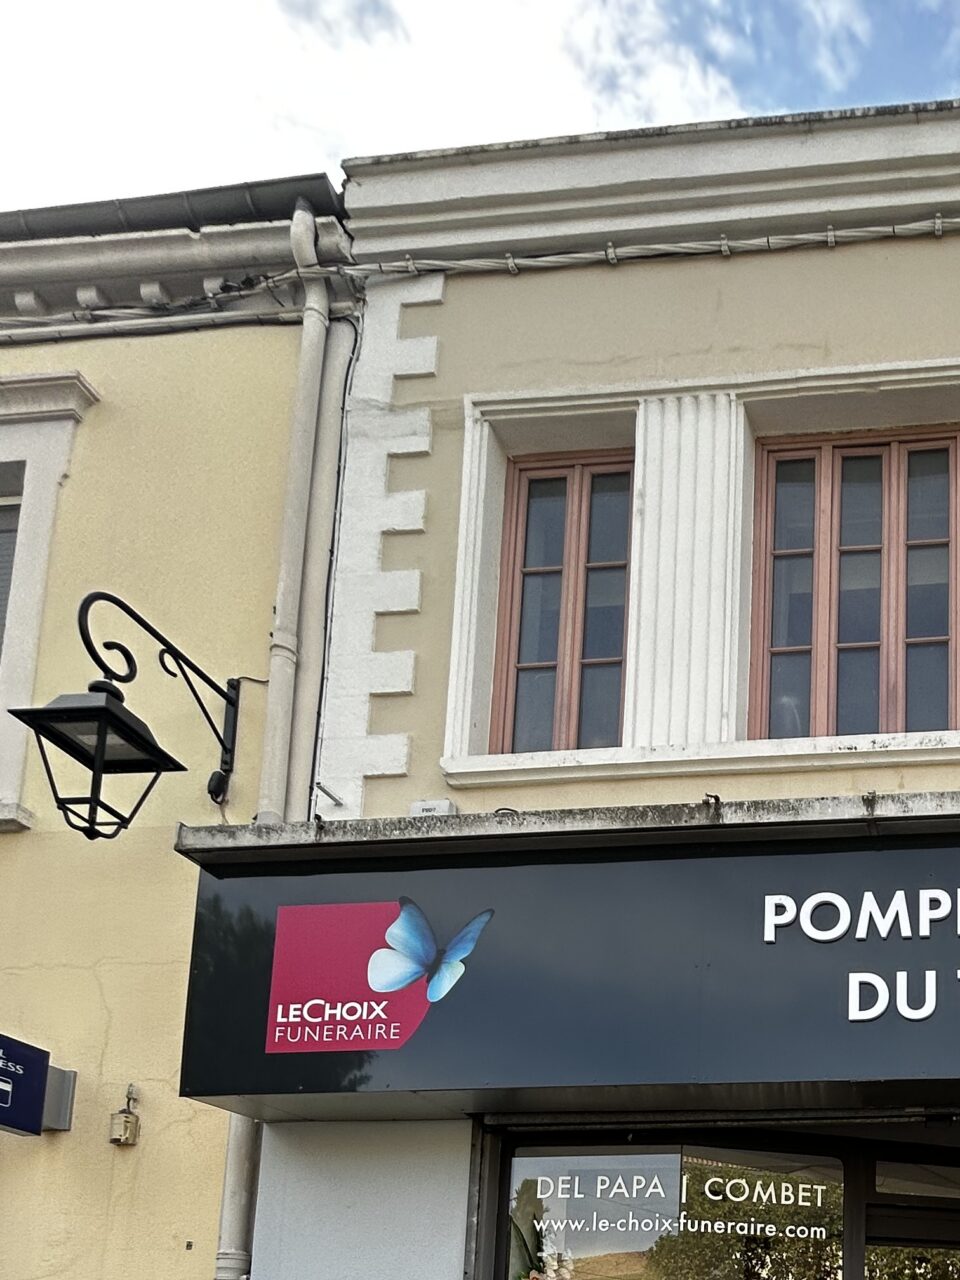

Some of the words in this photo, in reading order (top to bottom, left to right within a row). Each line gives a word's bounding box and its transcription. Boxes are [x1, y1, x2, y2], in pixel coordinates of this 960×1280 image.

[848, 970, 938, 1021] DU
[275, 1023, 401, 1042] FUNERAIRE
[536, 1176, 584, 1199] DEL
[596, 1175, 667, 1199] PAPA
[704, 1177, 827, 1208] COMBET
[533, 1211, 827, 1239] www.le-choix-funeraire.com
